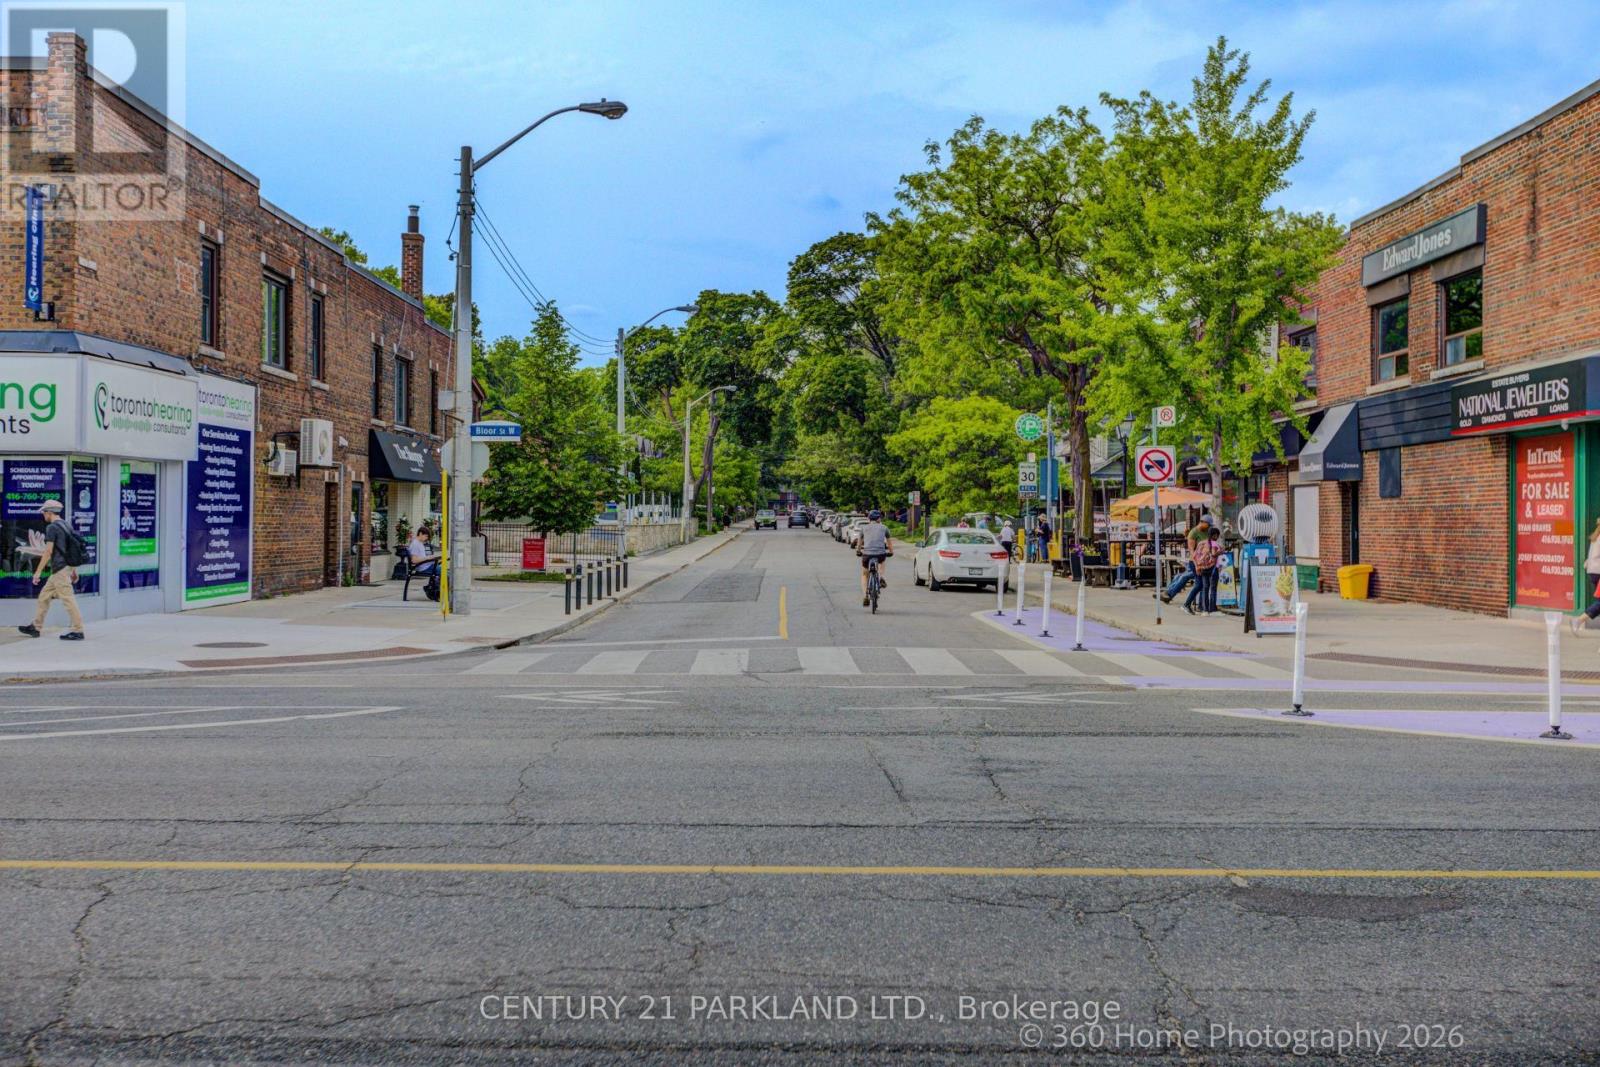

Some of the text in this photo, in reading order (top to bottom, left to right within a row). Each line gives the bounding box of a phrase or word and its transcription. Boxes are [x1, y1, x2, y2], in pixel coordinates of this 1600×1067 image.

[1383, 229, 1452, 271] Edward Jones
[1492, 374, 1529, 388] ESTATE BUYERS
[1459, 378, 1569, 418] NATIONAL JEWELLERS
[1459, 403, 1569, 428] GOLD DIAMONDS WATCHES LOANS
[1528, 446, 1562, 465] InTrust
[1021, 472, 1035, 481] 30
[122, 489, 136, 503] 35%
[1522, 482, 1569, 500] FOR SALE
[1525, 501, 1564, 518] & LEASED
[121, 516, 136, 530] 90%
